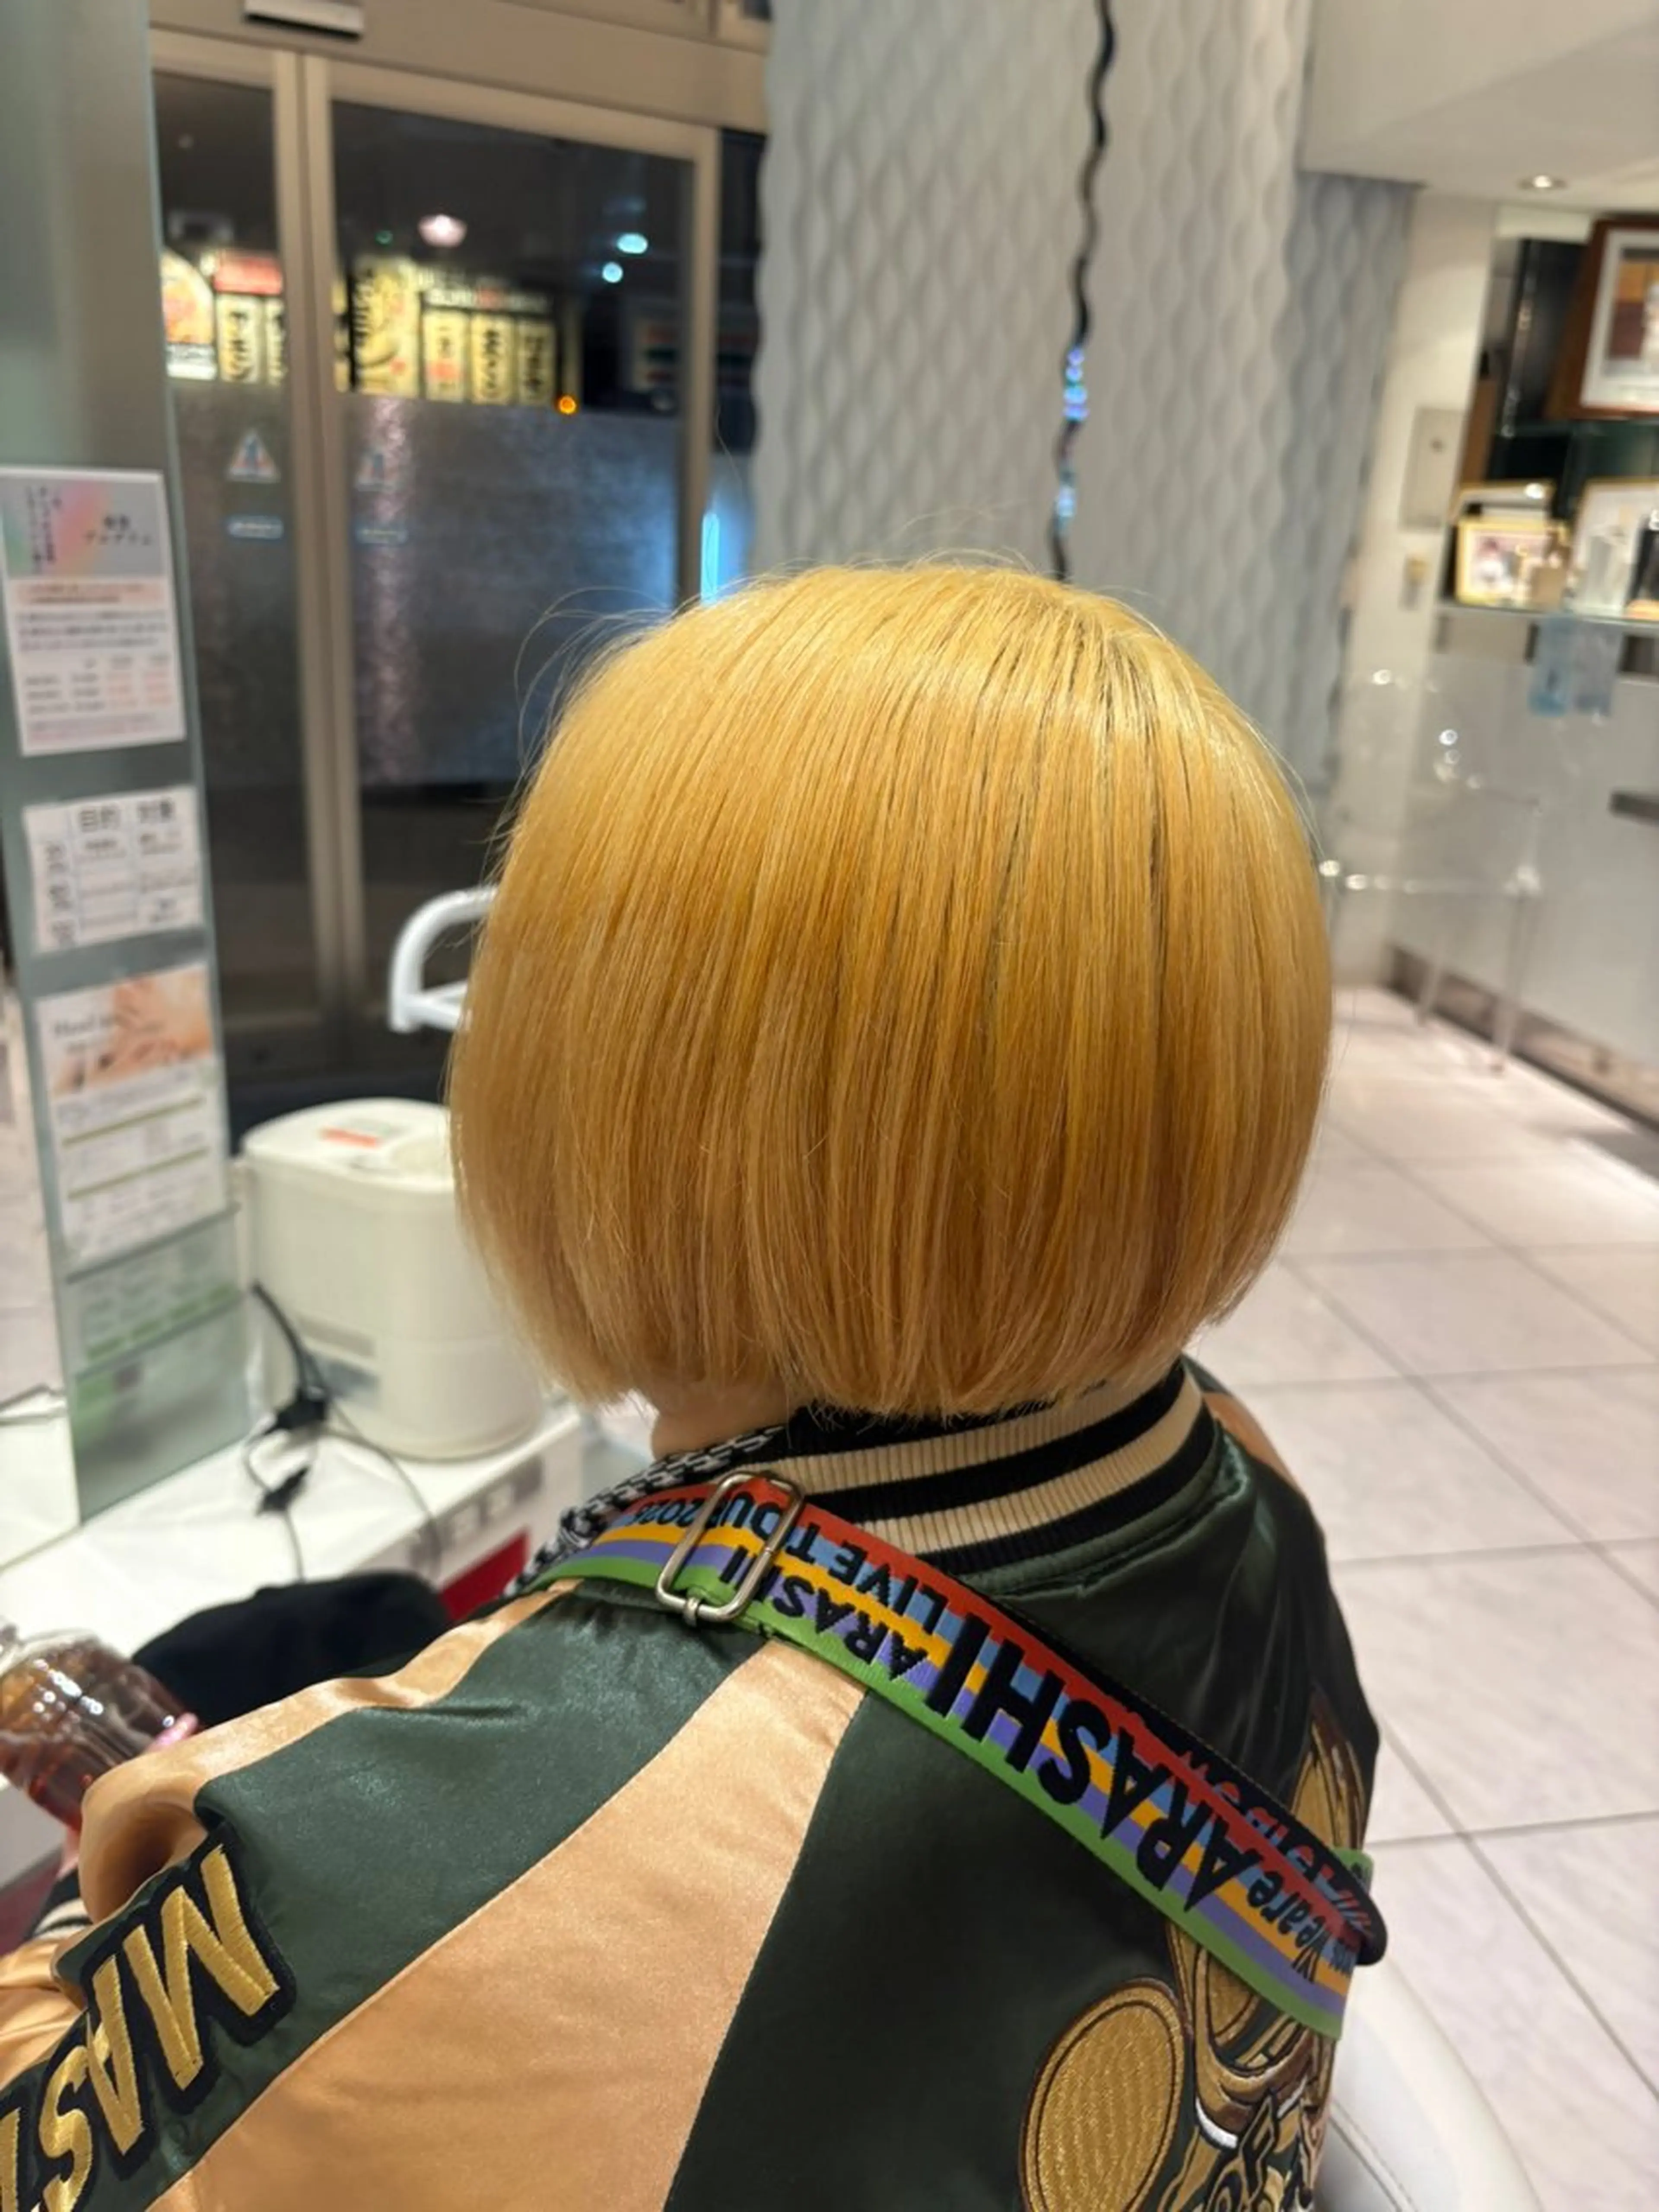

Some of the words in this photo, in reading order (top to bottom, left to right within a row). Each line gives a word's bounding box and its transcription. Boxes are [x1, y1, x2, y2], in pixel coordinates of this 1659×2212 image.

[827, 1539, 950, 1636] LIVE
[925, 1613, 1263, 1912] ARASHI
[1247, 1871, 1312, 1935] are
[1291, 1916, 1332, 1983] We
